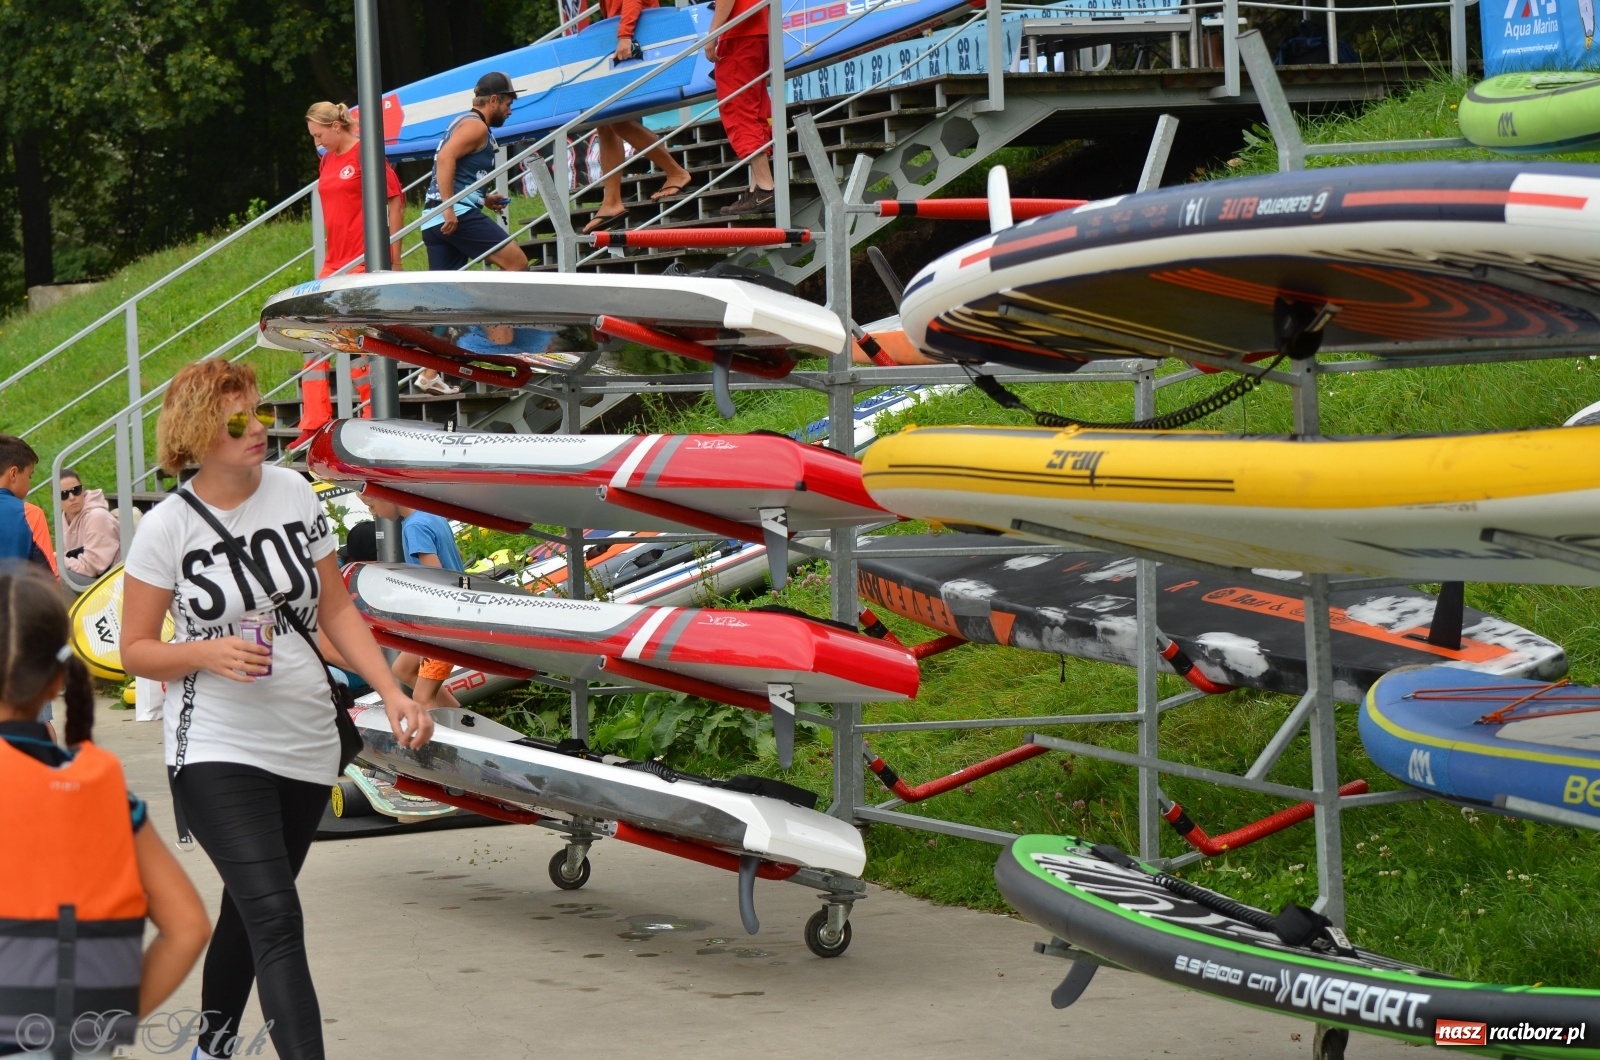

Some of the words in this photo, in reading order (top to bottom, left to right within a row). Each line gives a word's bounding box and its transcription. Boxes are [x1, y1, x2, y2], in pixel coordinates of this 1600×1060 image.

[1504, 22, 1530, 40] Aqua
[1533, 17, 1558, 35] Marina
[1218, 196, 1259, 220] ELITE
